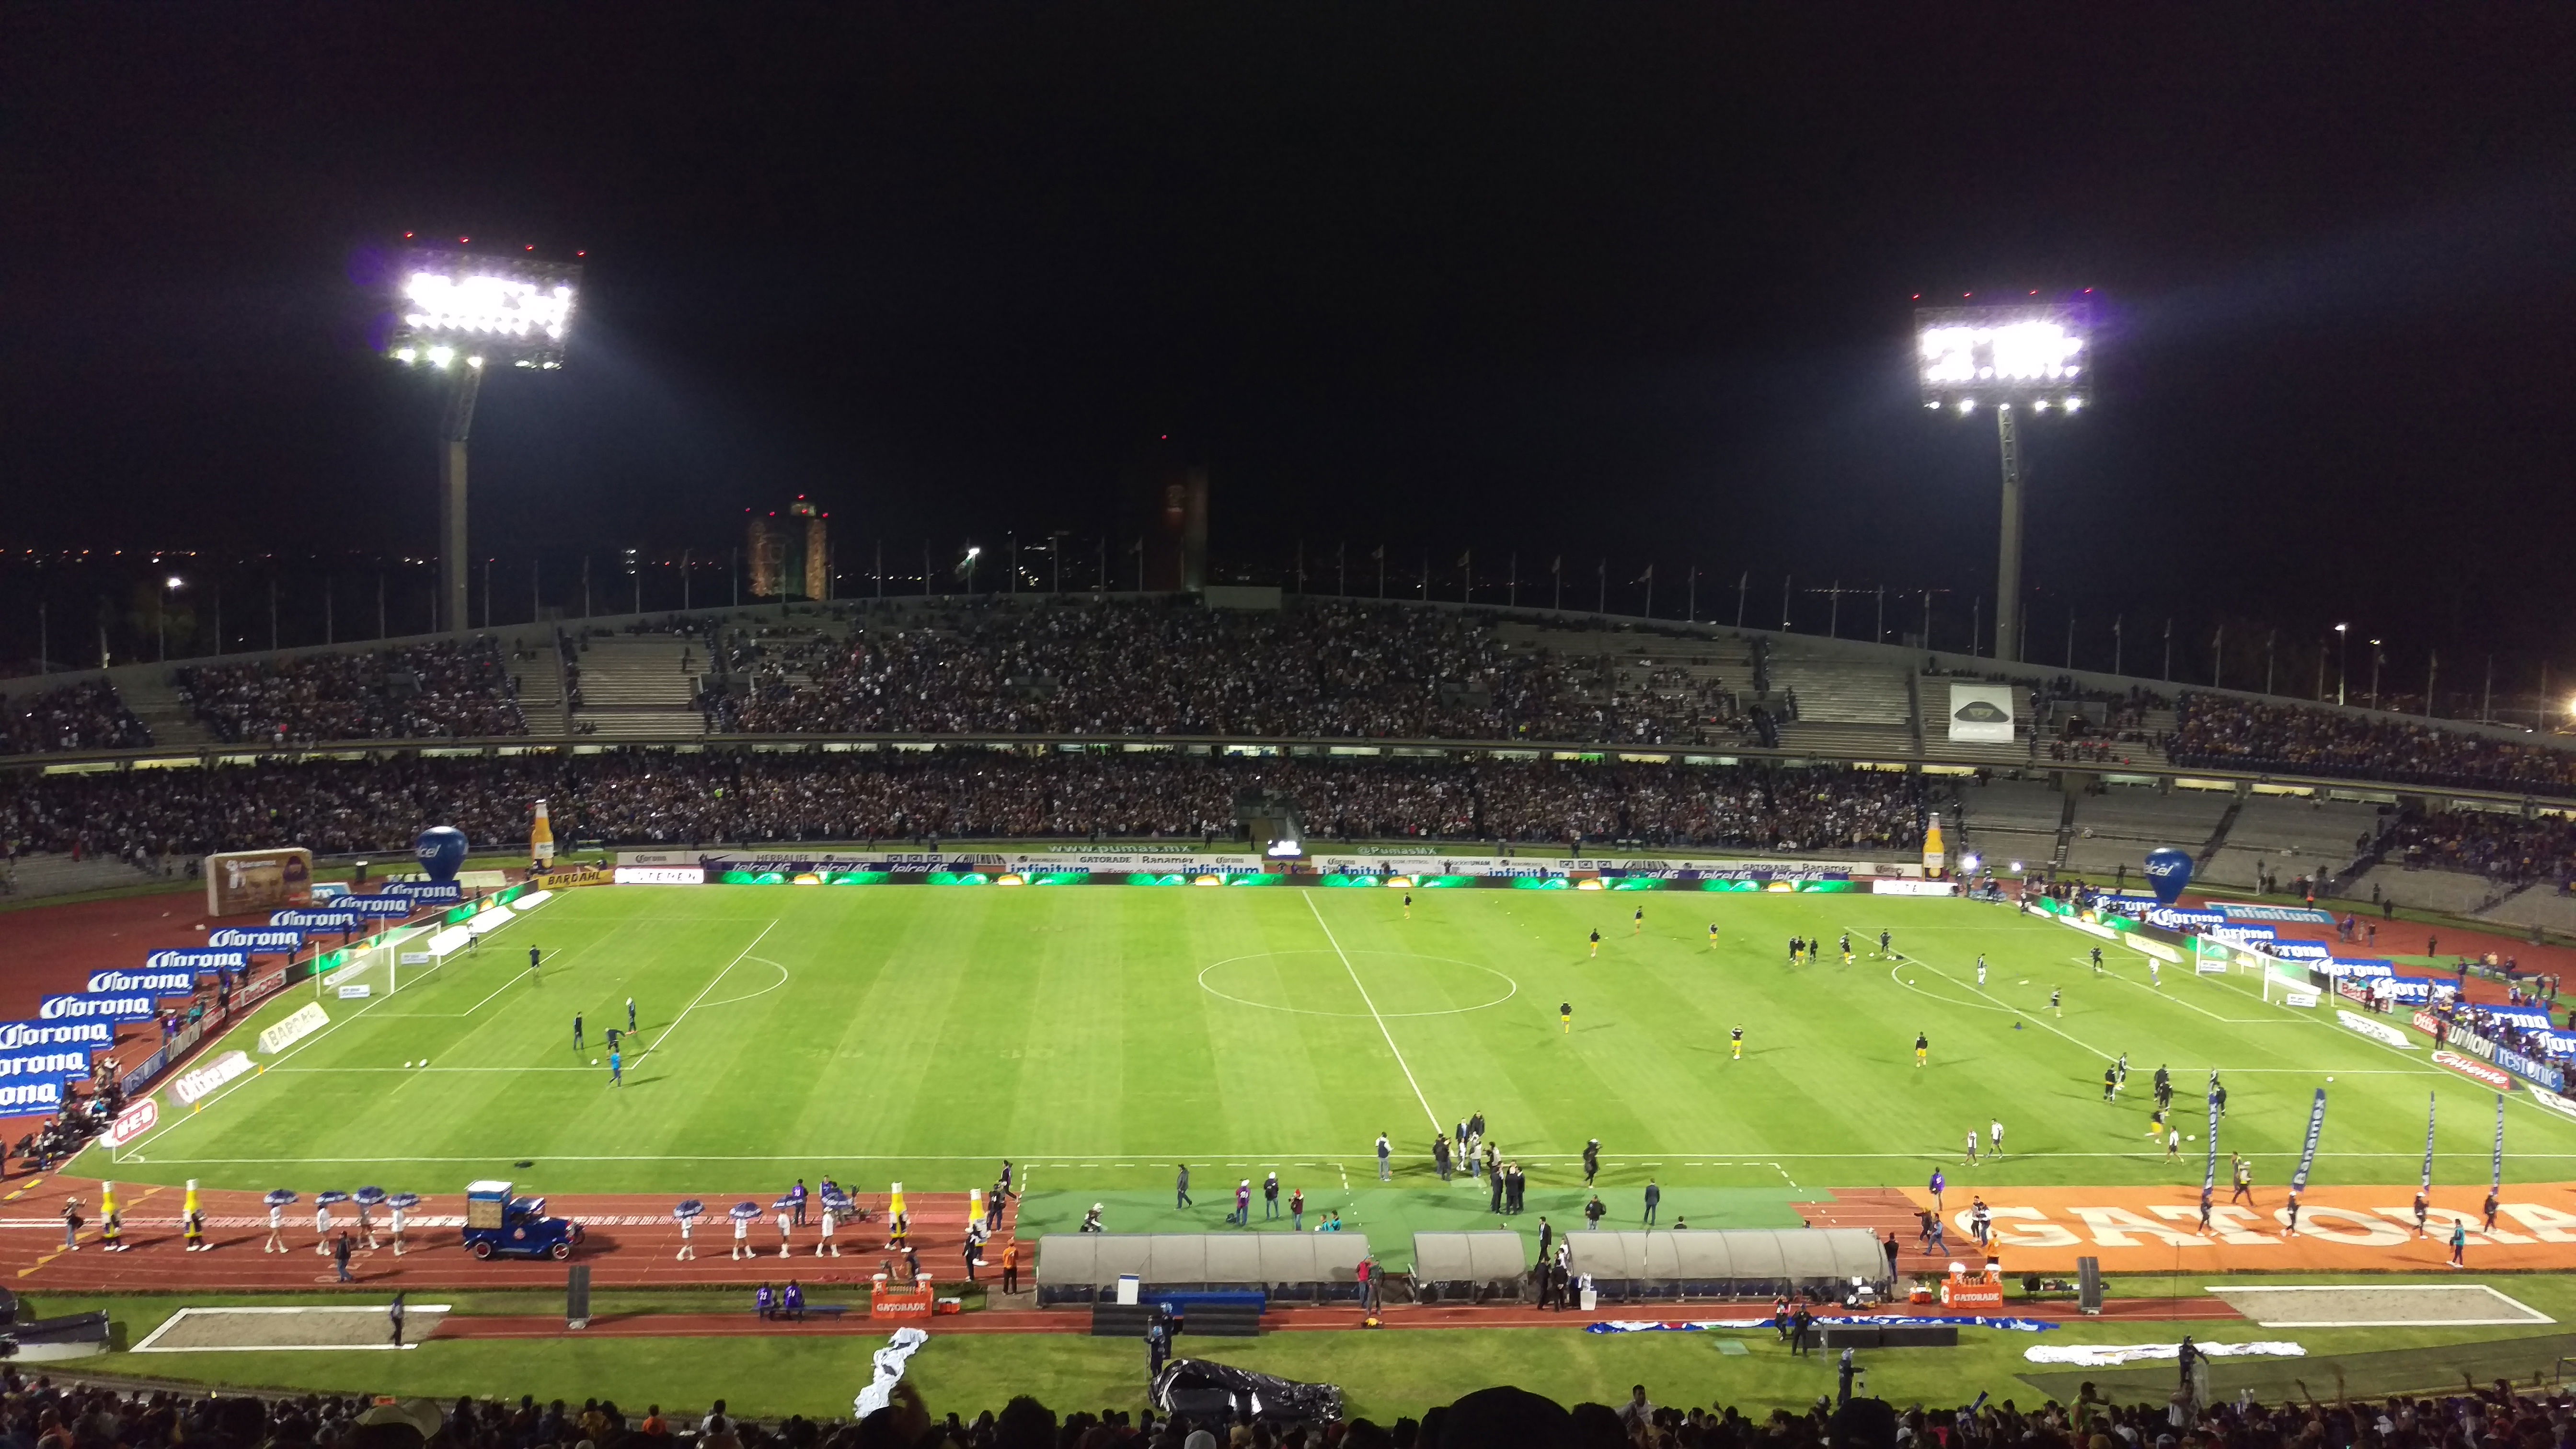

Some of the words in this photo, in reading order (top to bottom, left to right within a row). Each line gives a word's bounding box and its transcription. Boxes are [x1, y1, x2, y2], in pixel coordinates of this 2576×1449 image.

[416, 843, 441, 858] cel
[1048, 845, 1192, 854] www.pumas.mx
[1357, 846, 1437, 855] @PumasMX
[635, 854, 667, 862] Corona
[756, 854, 809, 862] HERBALIFE
[1142, 856, 1194, 864] Banamex
[1216, 856, 1244, 864] Corona
[1011, 863, 1090, 873] infinitum
[1183, 864, 1259, 874] infinitum
[1489, 867, 1565, 877] infinitm
[1803, 863, 1853, 873] Banamex
[547, 871, 601, 886] BARDAHL
[381, 884, 457, 897] Corona
[328, 896, 408, 912] Corona
[270, 910, 354, 927] Corona
[2224, 906, 2325, 923] infinitum
[208, 929, 299, 948] Corona
[146, 950, 243, 968] Corona
[87, 971, 191, 993] Corona
[39, 995, 151, 1020] Corona
[0, 1023, 109, 1050] Corona
[2448, 1024, 2494, 1058] UNION
[2431, 1050, 2508, 1084] Caliente
[116, 1103, 154, 1138] H-E-B
[1954, 1292, 2000, 1301] GATORADE
[876, 1303, 926, 1311] GATORADE
